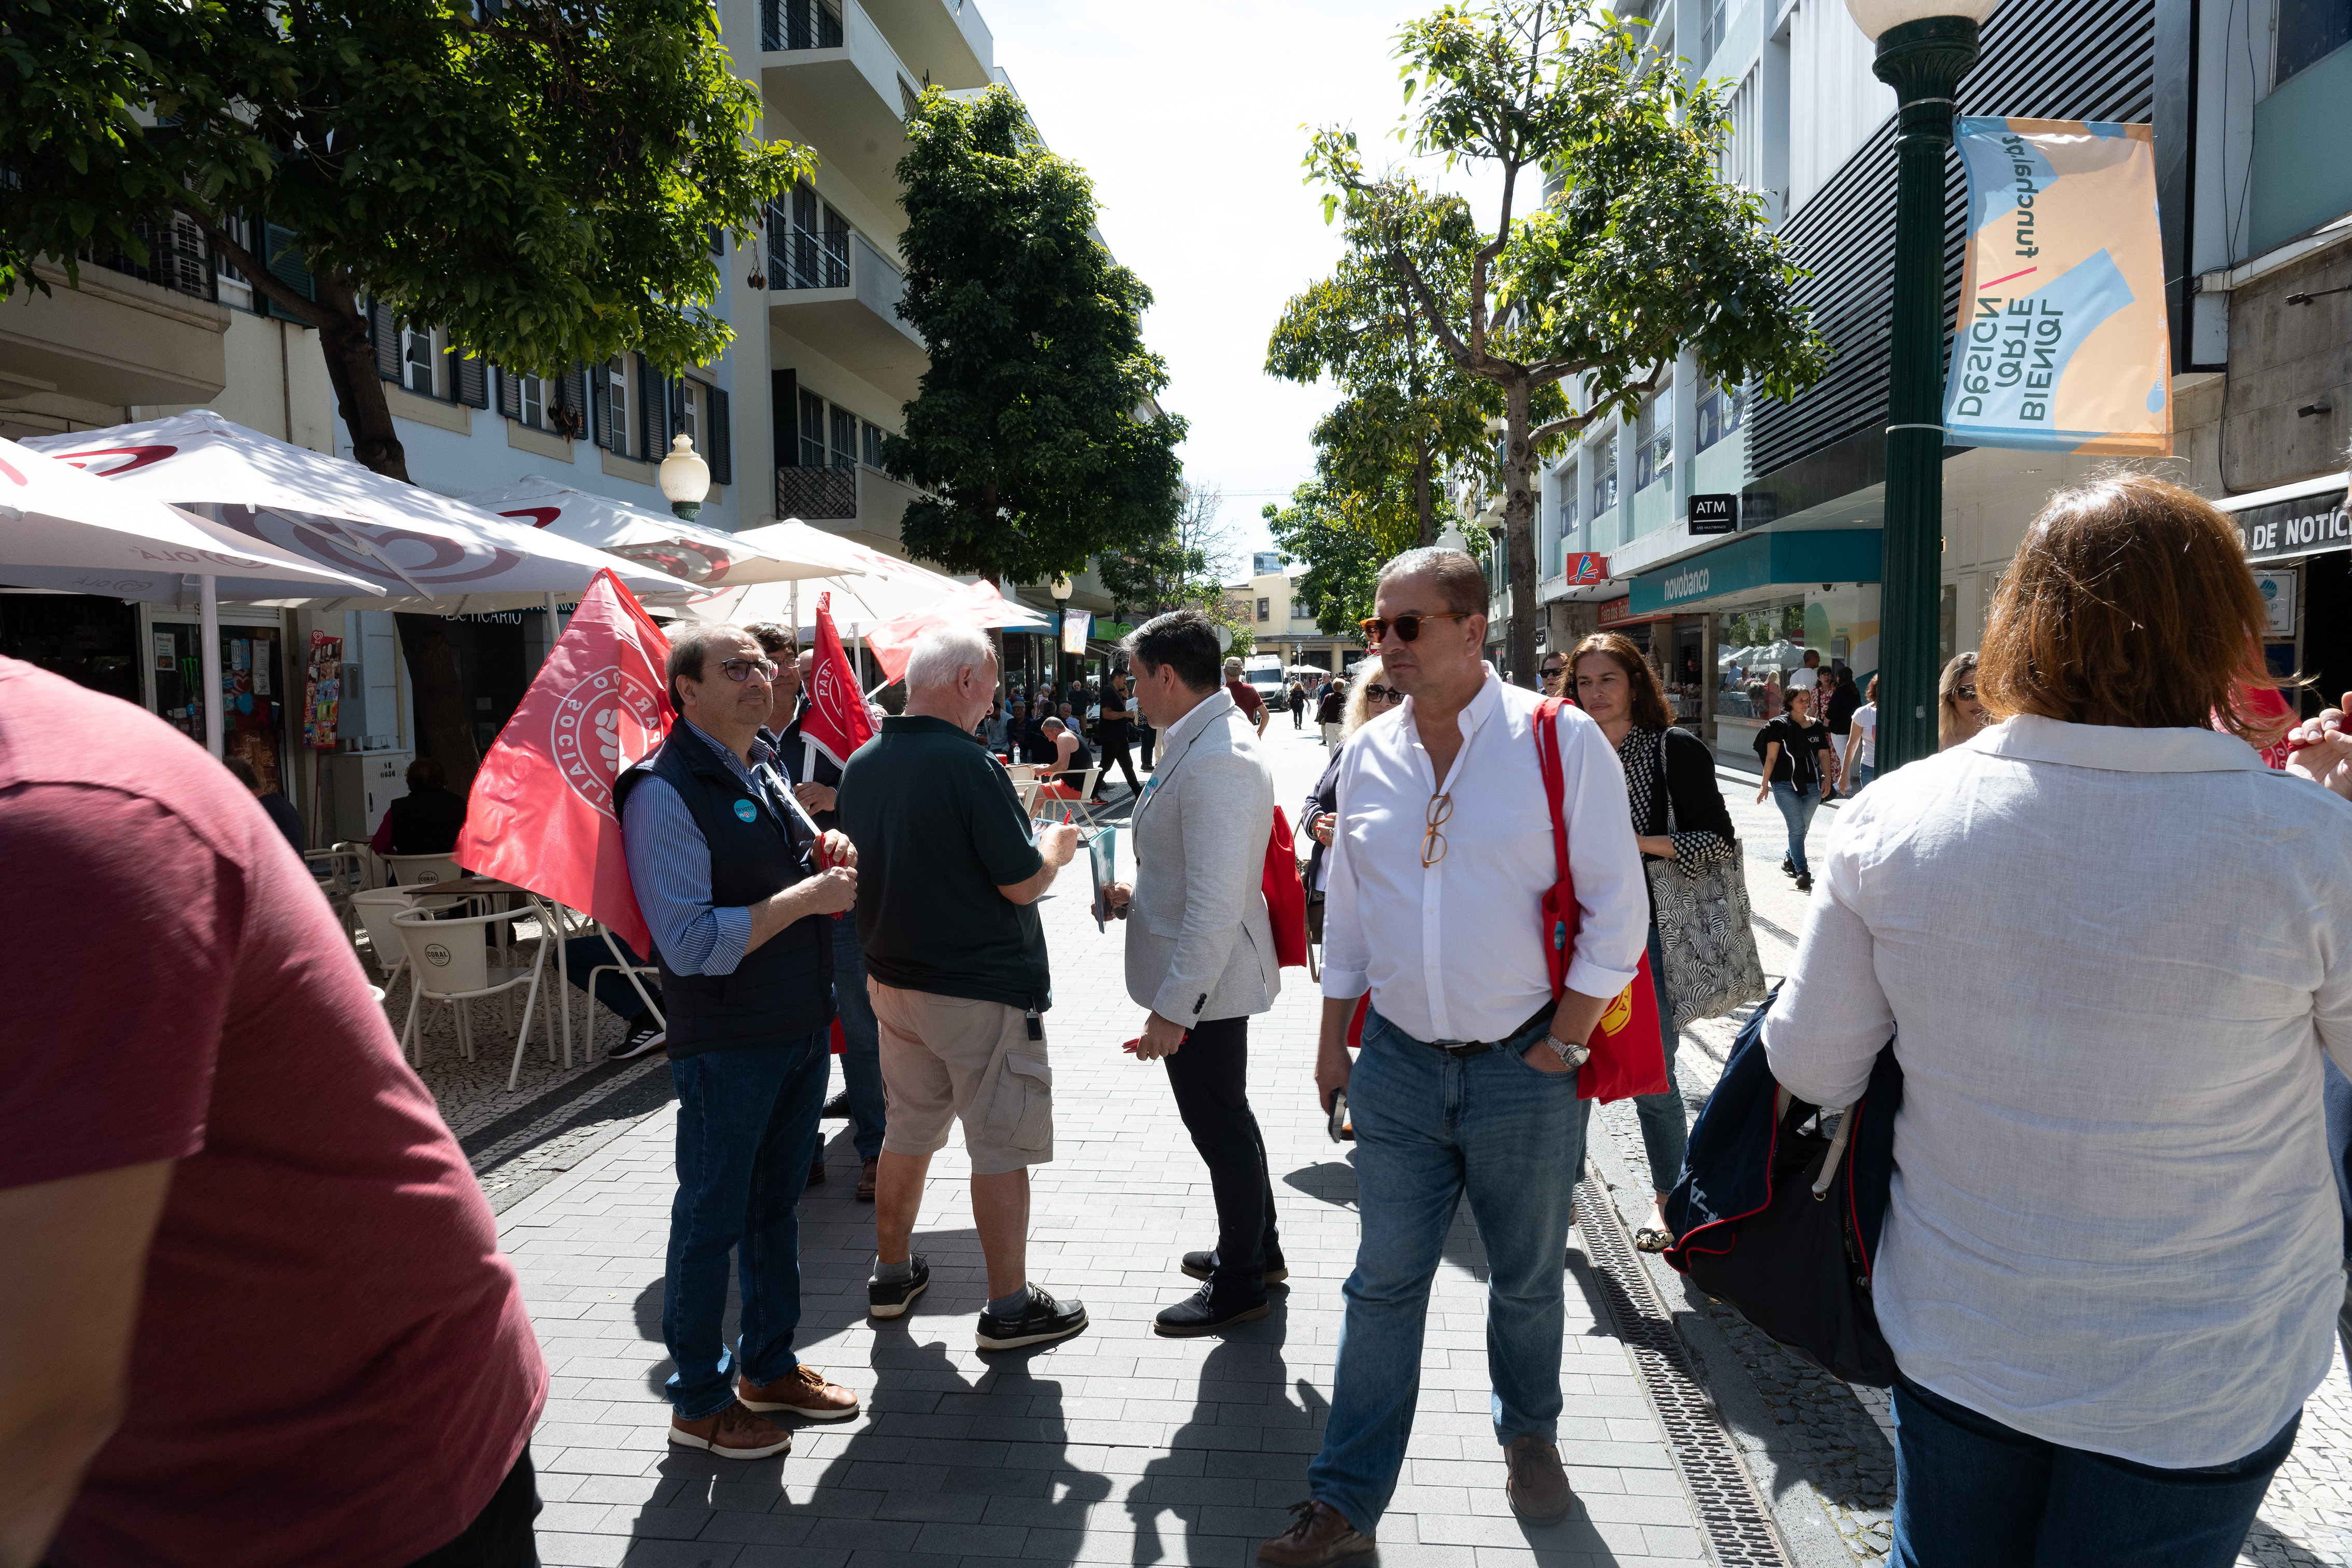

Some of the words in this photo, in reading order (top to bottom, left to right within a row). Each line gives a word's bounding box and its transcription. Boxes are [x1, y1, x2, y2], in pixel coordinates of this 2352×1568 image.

[1696, 501, 1726, 514] ATM
[2252, 523, 2278, 551] DE
[2285, 507, 2352, 545] NOTÍC
[1664, 567, 1709, 601] novobanco
[1601, 604, 1611, 622] Feira
[1618, 600, 1629, 618] Tecid
[819, 663, 834, 696] PART
